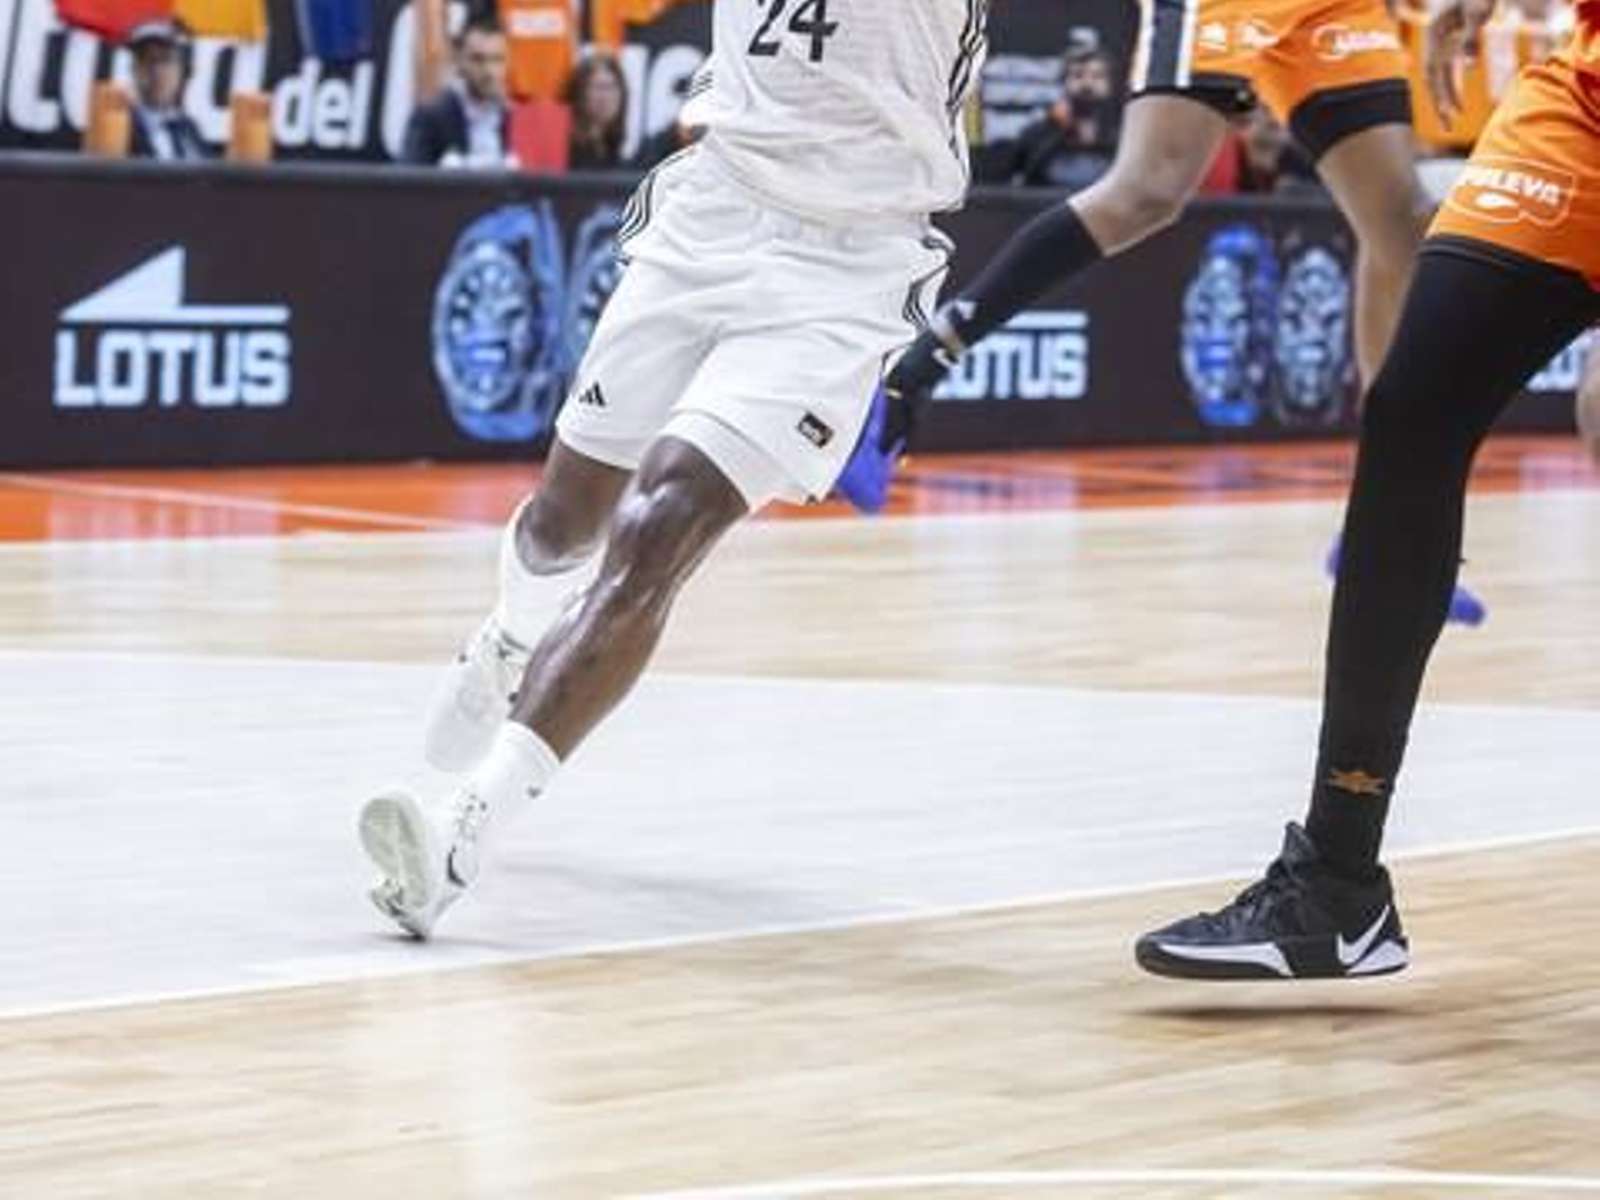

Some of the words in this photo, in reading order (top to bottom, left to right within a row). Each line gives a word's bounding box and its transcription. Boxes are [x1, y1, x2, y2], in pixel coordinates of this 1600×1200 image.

[272, 56, 374, 149] del
[54, 331, 290, 406] LOTUS
[932, 332, 1089, 400] OTUS
